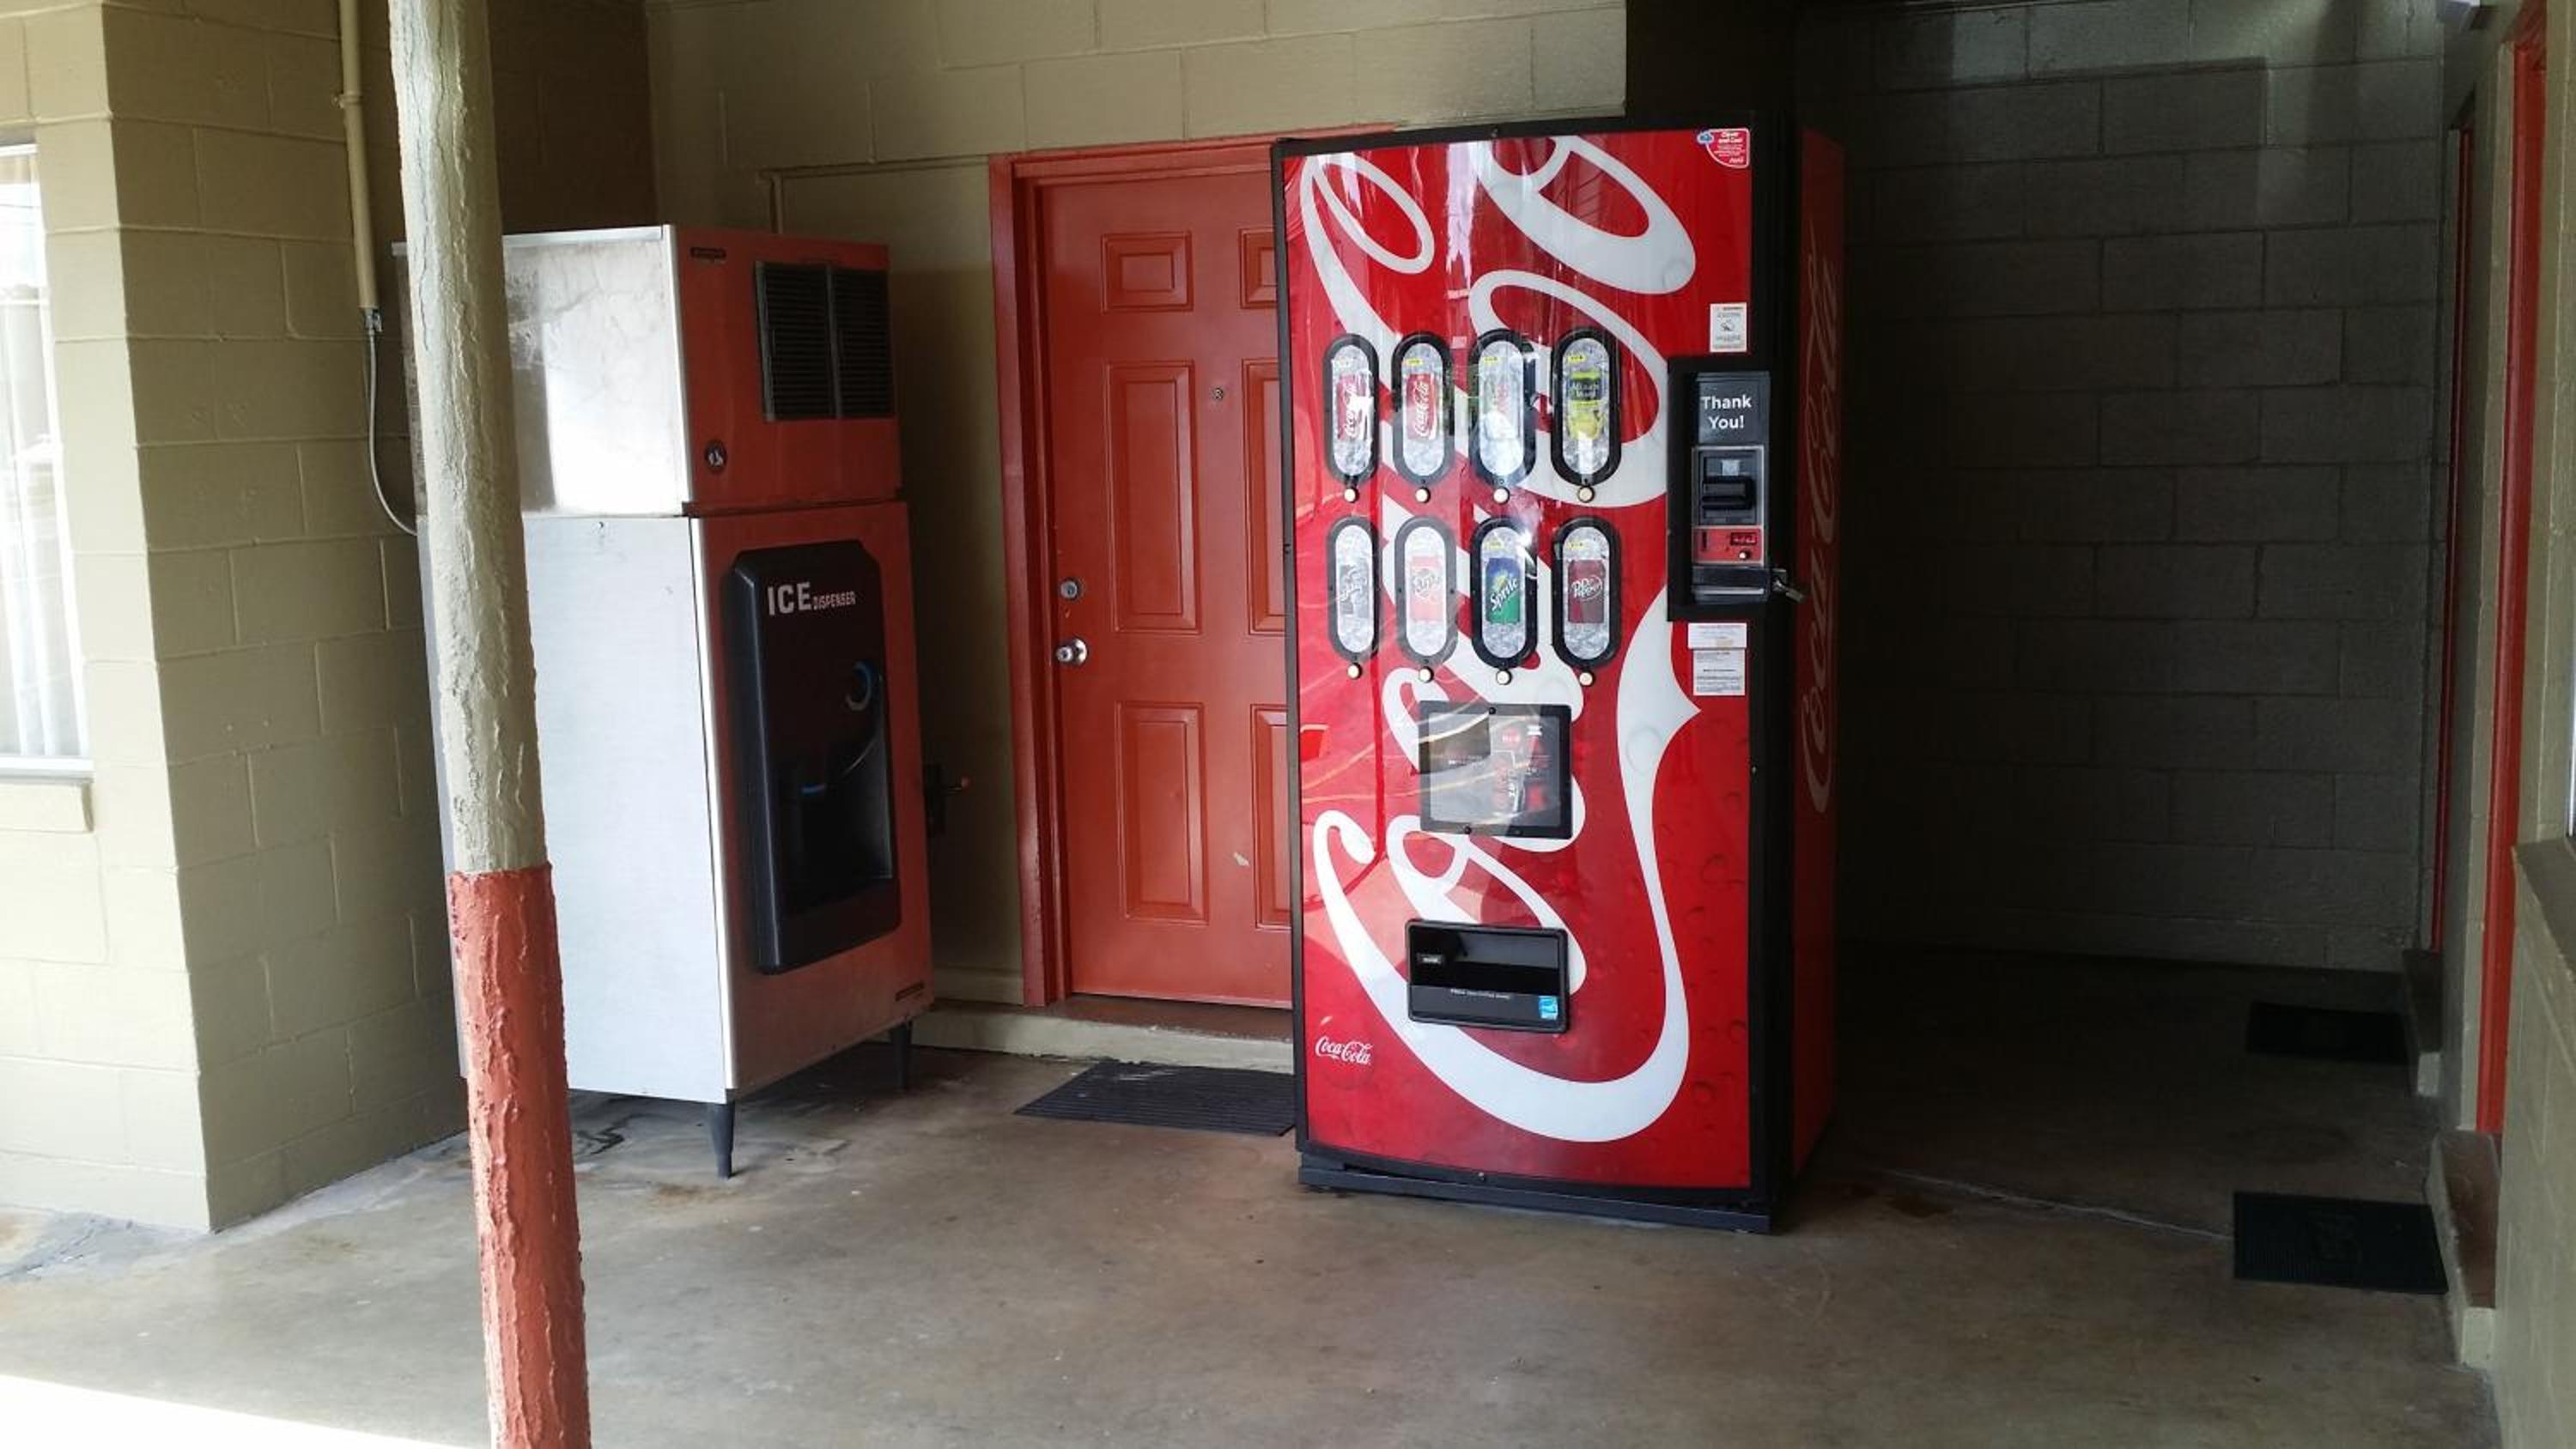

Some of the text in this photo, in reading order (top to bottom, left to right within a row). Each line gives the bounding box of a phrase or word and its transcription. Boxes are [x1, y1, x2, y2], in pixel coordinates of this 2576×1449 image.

[1700, 395, 1752, 409] Thank
[1708, 415, 1744, 429] You!
[767, 582, 811, 615] ICE
[1491, 577, 1519, 611] Sprite
[1315, 1036, 1373, 1065] Coca-Cola
